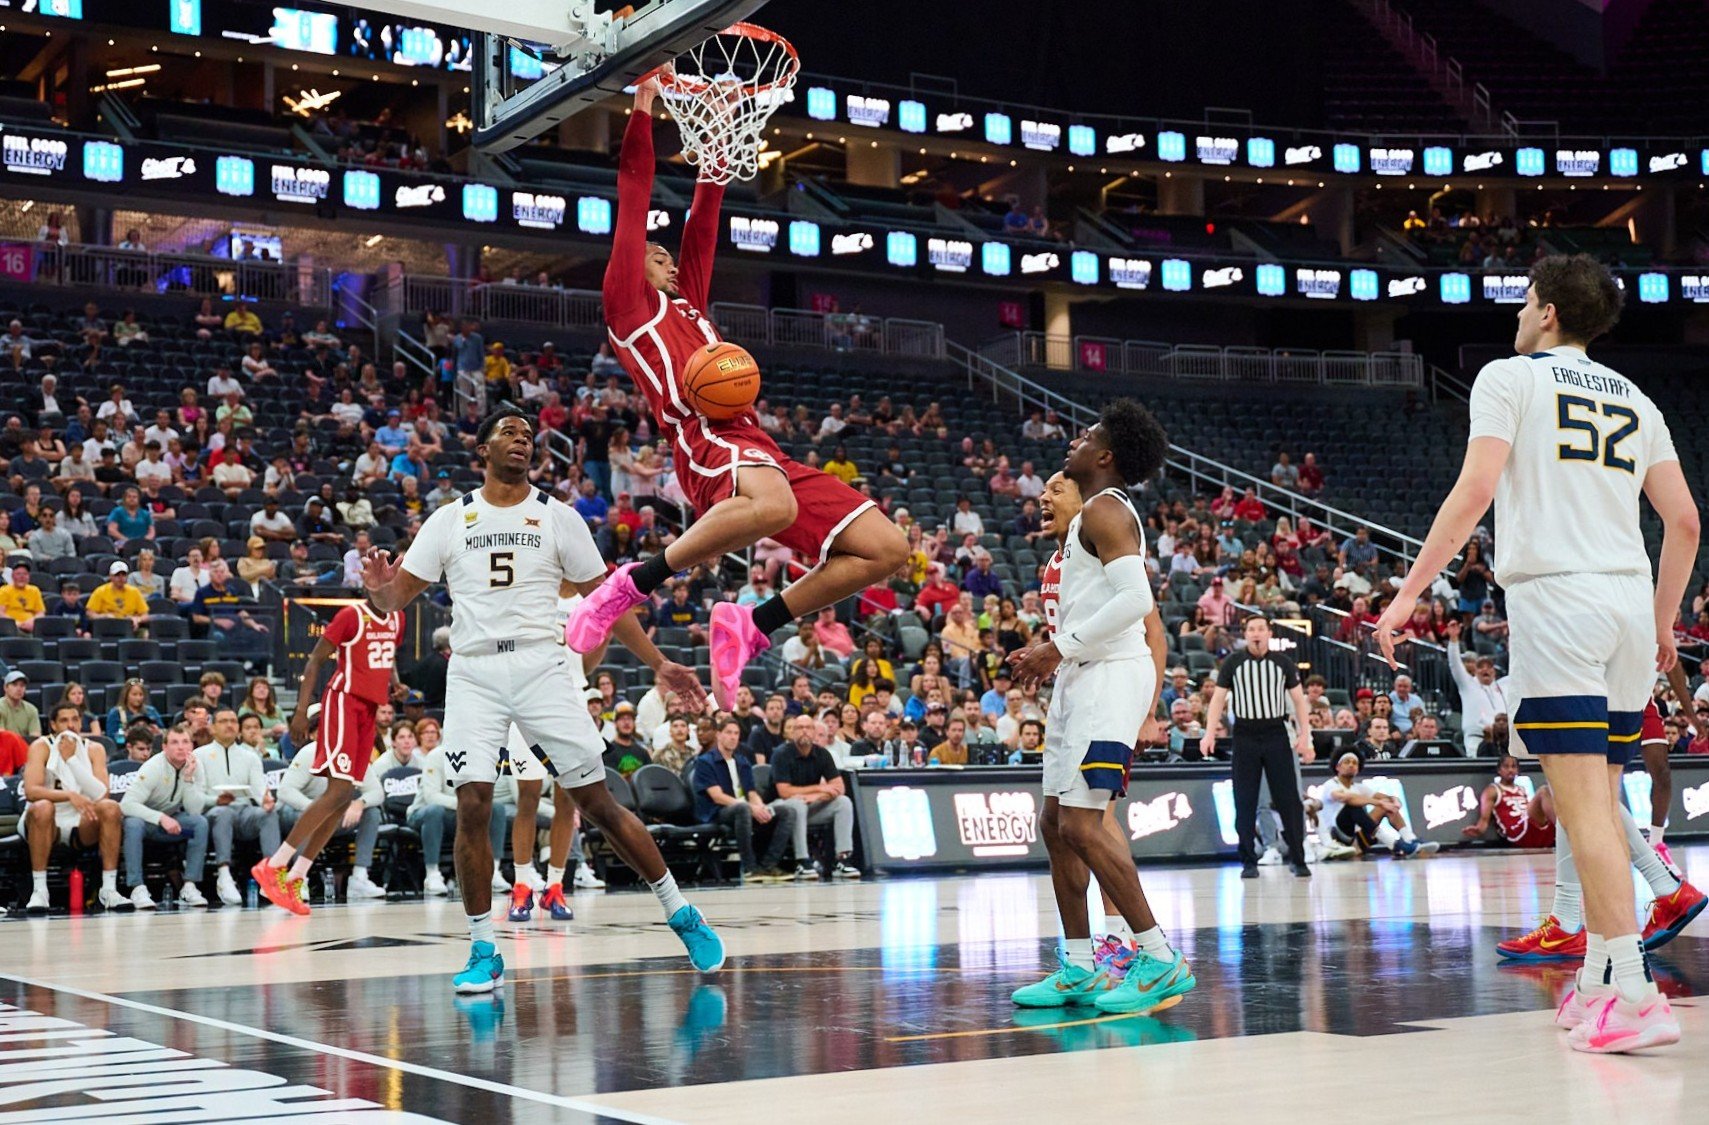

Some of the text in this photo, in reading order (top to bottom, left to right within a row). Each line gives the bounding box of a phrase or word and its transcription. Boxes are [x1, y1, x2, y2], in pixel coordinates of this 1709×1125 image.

[5, 148, 66, 170] ENERGY
[513, 203, 564, 224] ENERGY
[3, 252, 25, 273] 16
[1086, 348, 1101, 366] 14
[1552, 366, 1631, 398] EAGLESTAFF
[1555, 391, 1640, 476] 52
[465, 532, 541, 550] MOUNTAINEERS
[489, 551, 515, 588] 5
[366, 640, 396, 669] 22
[496, 639, 515, 653] WVU
[961, 814, 1036, 845] ENERGY
